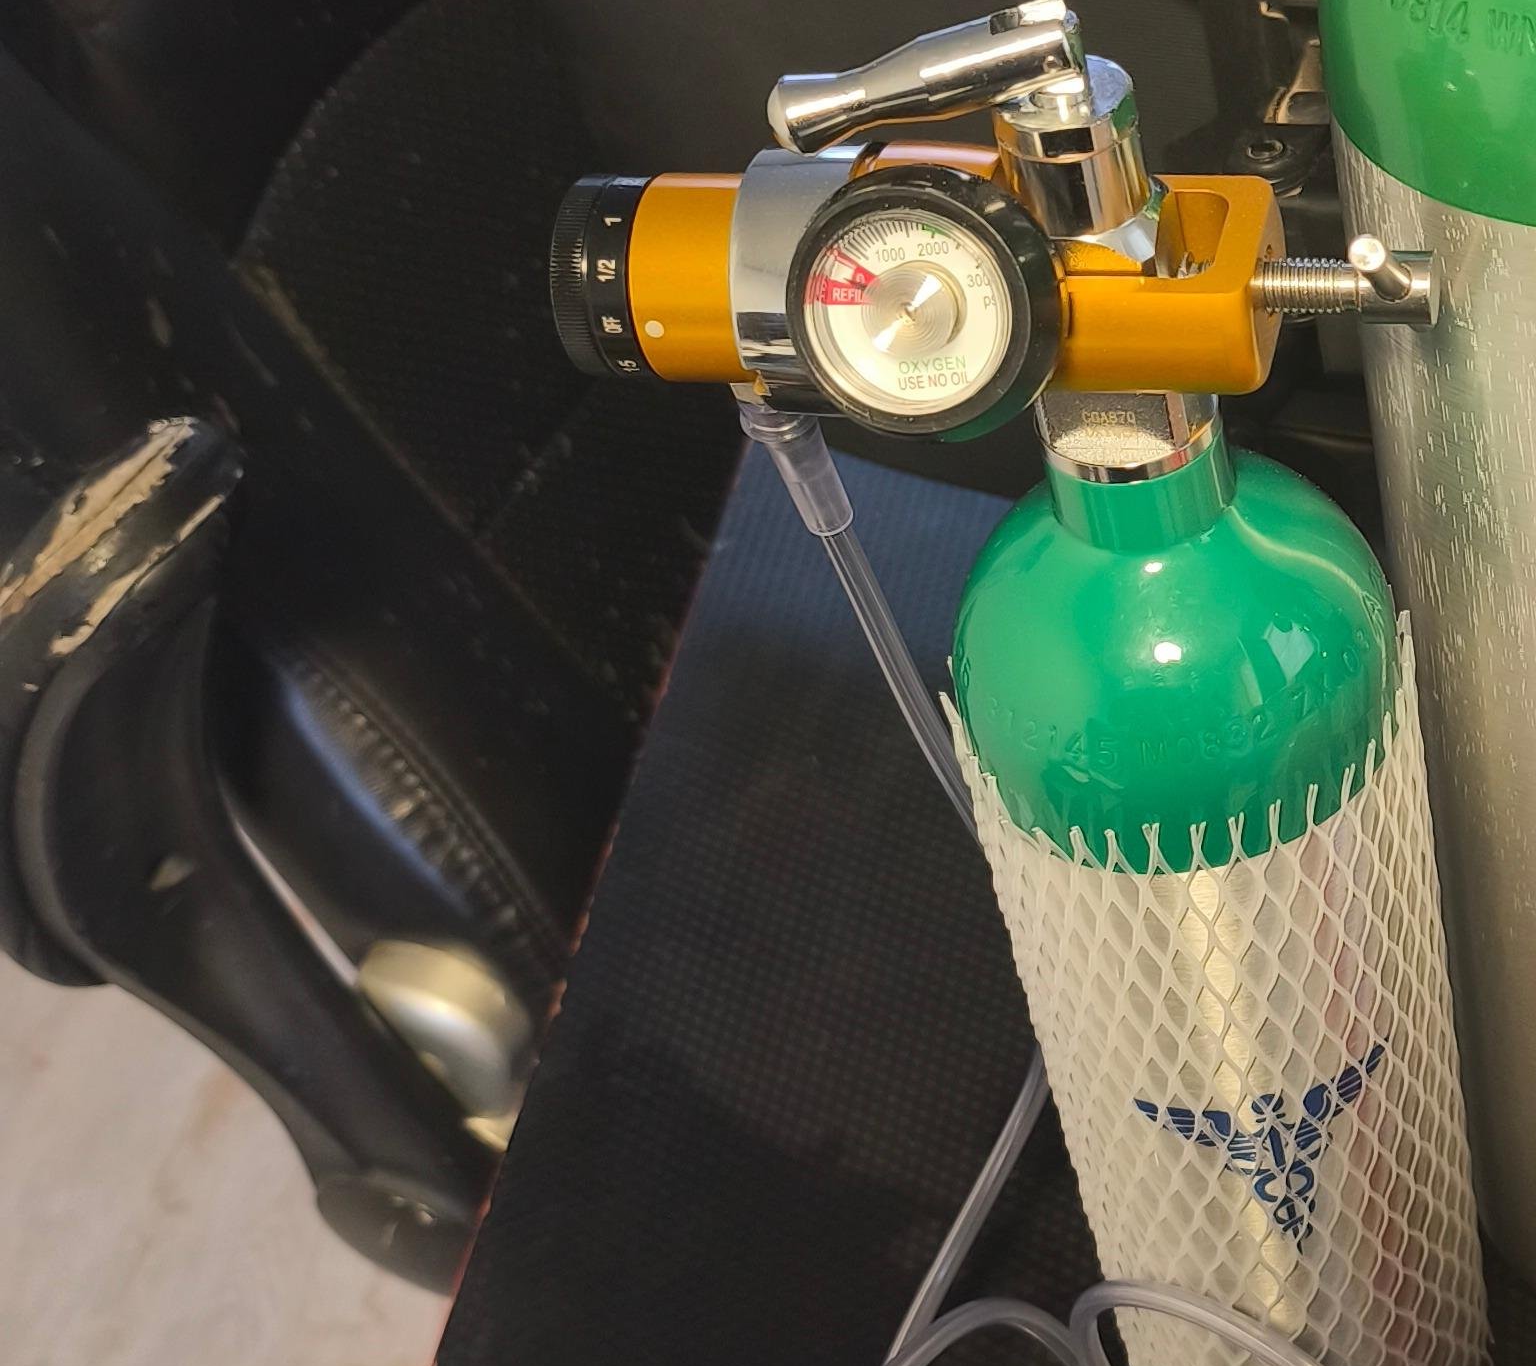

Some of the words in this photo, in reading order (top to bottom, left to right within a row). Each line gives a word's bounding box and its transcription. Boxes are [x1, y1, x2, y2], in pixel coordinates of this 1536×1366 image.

[604, 216, 622, 227] 1
[875, 247, 906, 262] 1000
[916, 240, 949, 257] 2000
[596, 258, 616, 283] 1/2
[601, 314, 623, 334] OFF
[898, 355, 967, 375] OXYGEN
[898, 373, 925, 391] USE
[928, 372, 948, 389] NO
[952, 371, 971, 386] OIL
